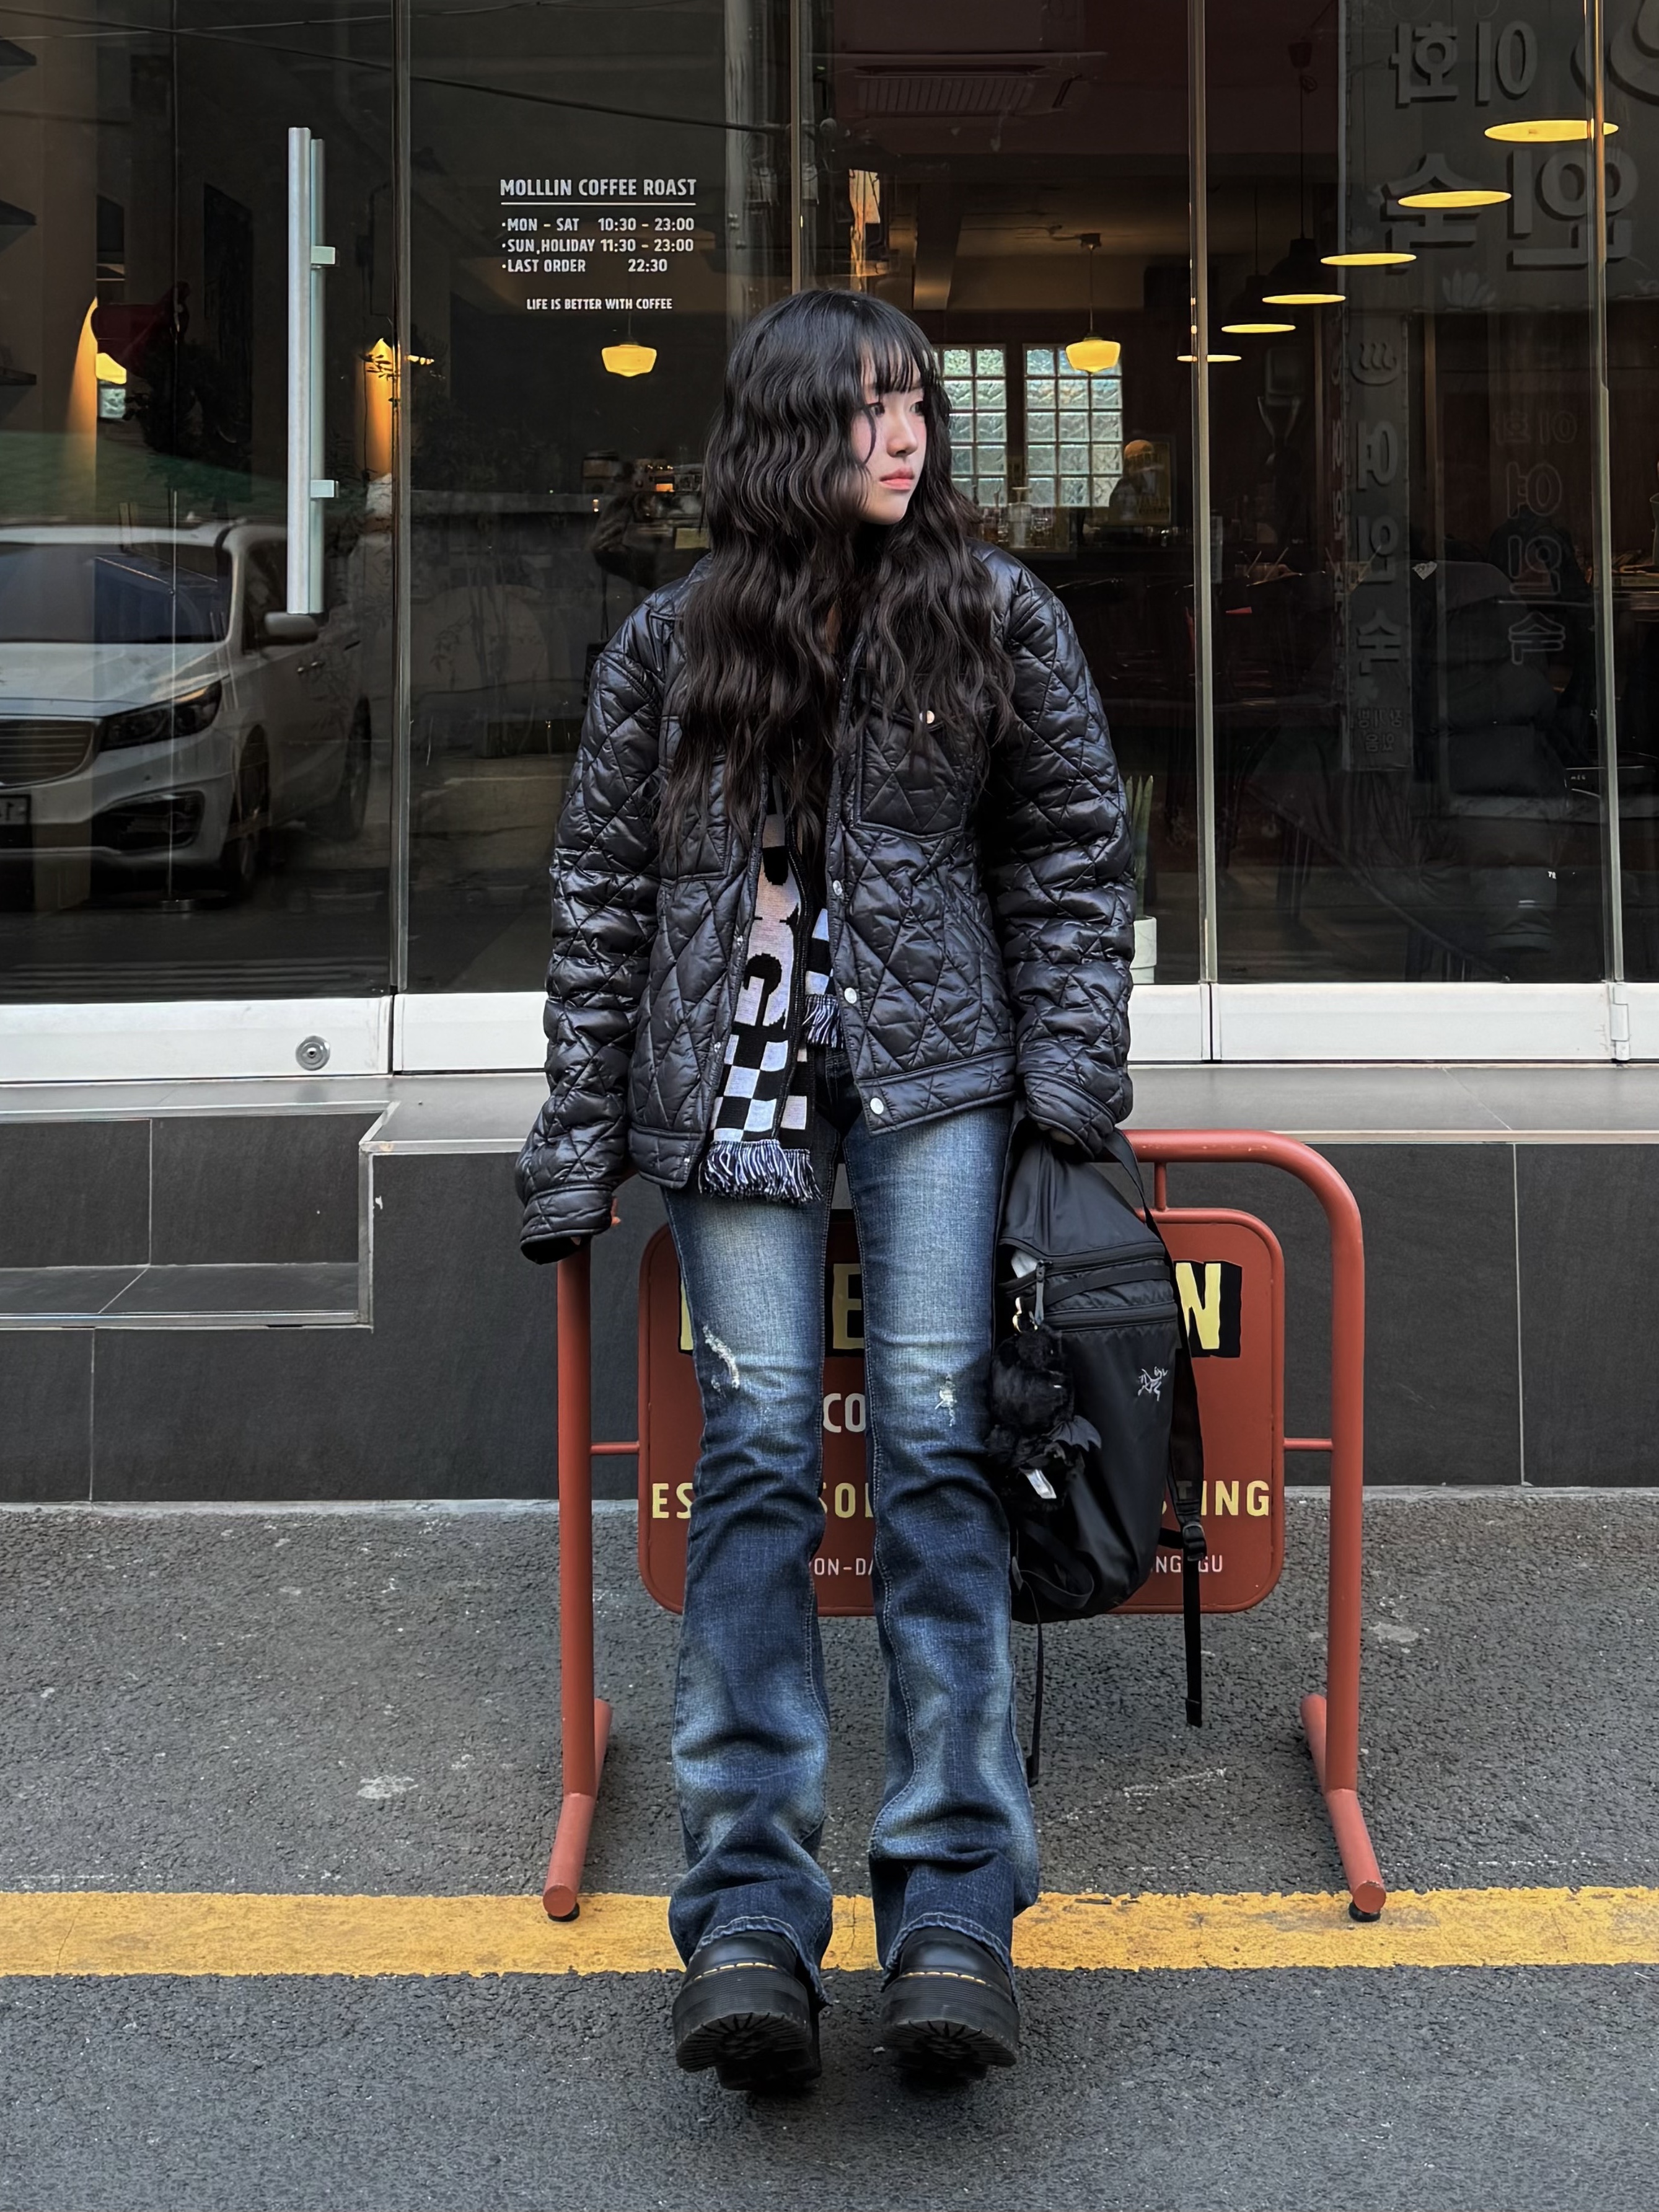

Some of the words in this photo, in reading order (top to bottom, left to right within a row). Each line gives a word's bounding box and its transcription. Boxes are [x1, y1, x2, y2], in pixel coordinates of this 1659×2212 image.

[500, 179, 572, 196] MOLLLIN
[578, 178, 637, 196] COFFEE
[643, 178, 697, 196] ROAST
[556, 218, 579, 231] SAT
[597, 218, 636, 232] 10:30
[654, 217, 694, 231] 23:00
[600, 238, 636, 252] 11:30
[654, 238, 694, 252] 23:00
[508, 258, 539, 273] LAST
[543, 258, 586, 273] ORDER
[628, 258, 667, 273] 22:30
[526, 298, 548, 310] LIFE
[550, 298, 561, 310] IS
[564, 298, 602, 310] BETTER
[605, 298, 633, 310] WITH
[635, 298, 672, 309] COFFEE
